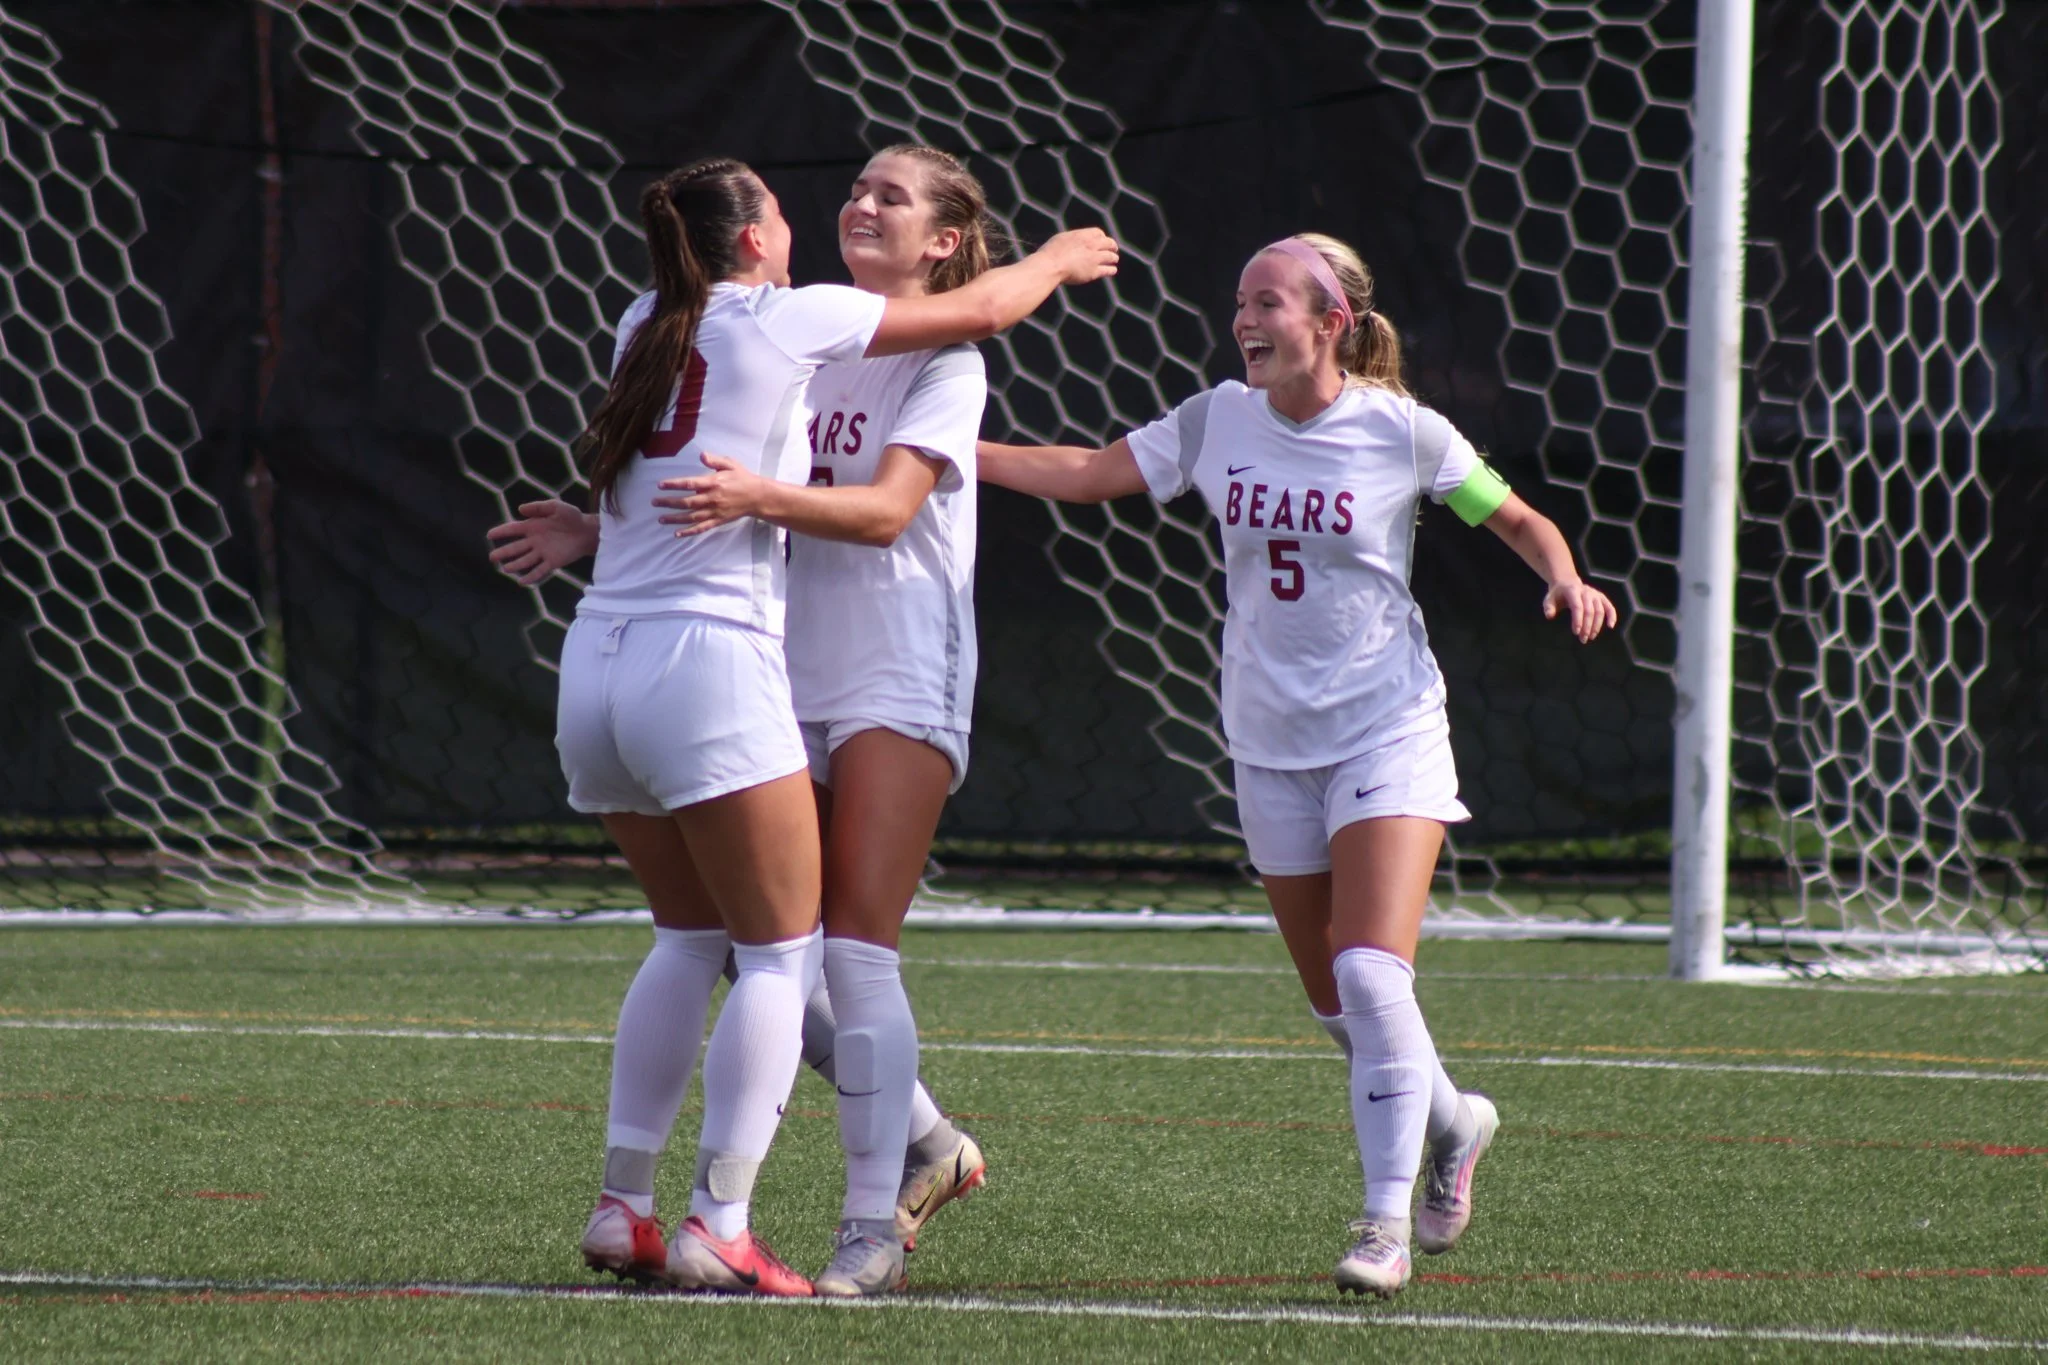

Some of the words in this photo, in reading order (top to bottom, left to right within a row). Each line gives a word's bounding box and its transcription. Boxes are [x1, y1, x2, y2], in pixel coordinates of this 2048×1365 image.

[808, 411, 868, 456] ARS
[1226, 481, 1355, 536] BEARS
[1267, 539, 1305, 602] 5
